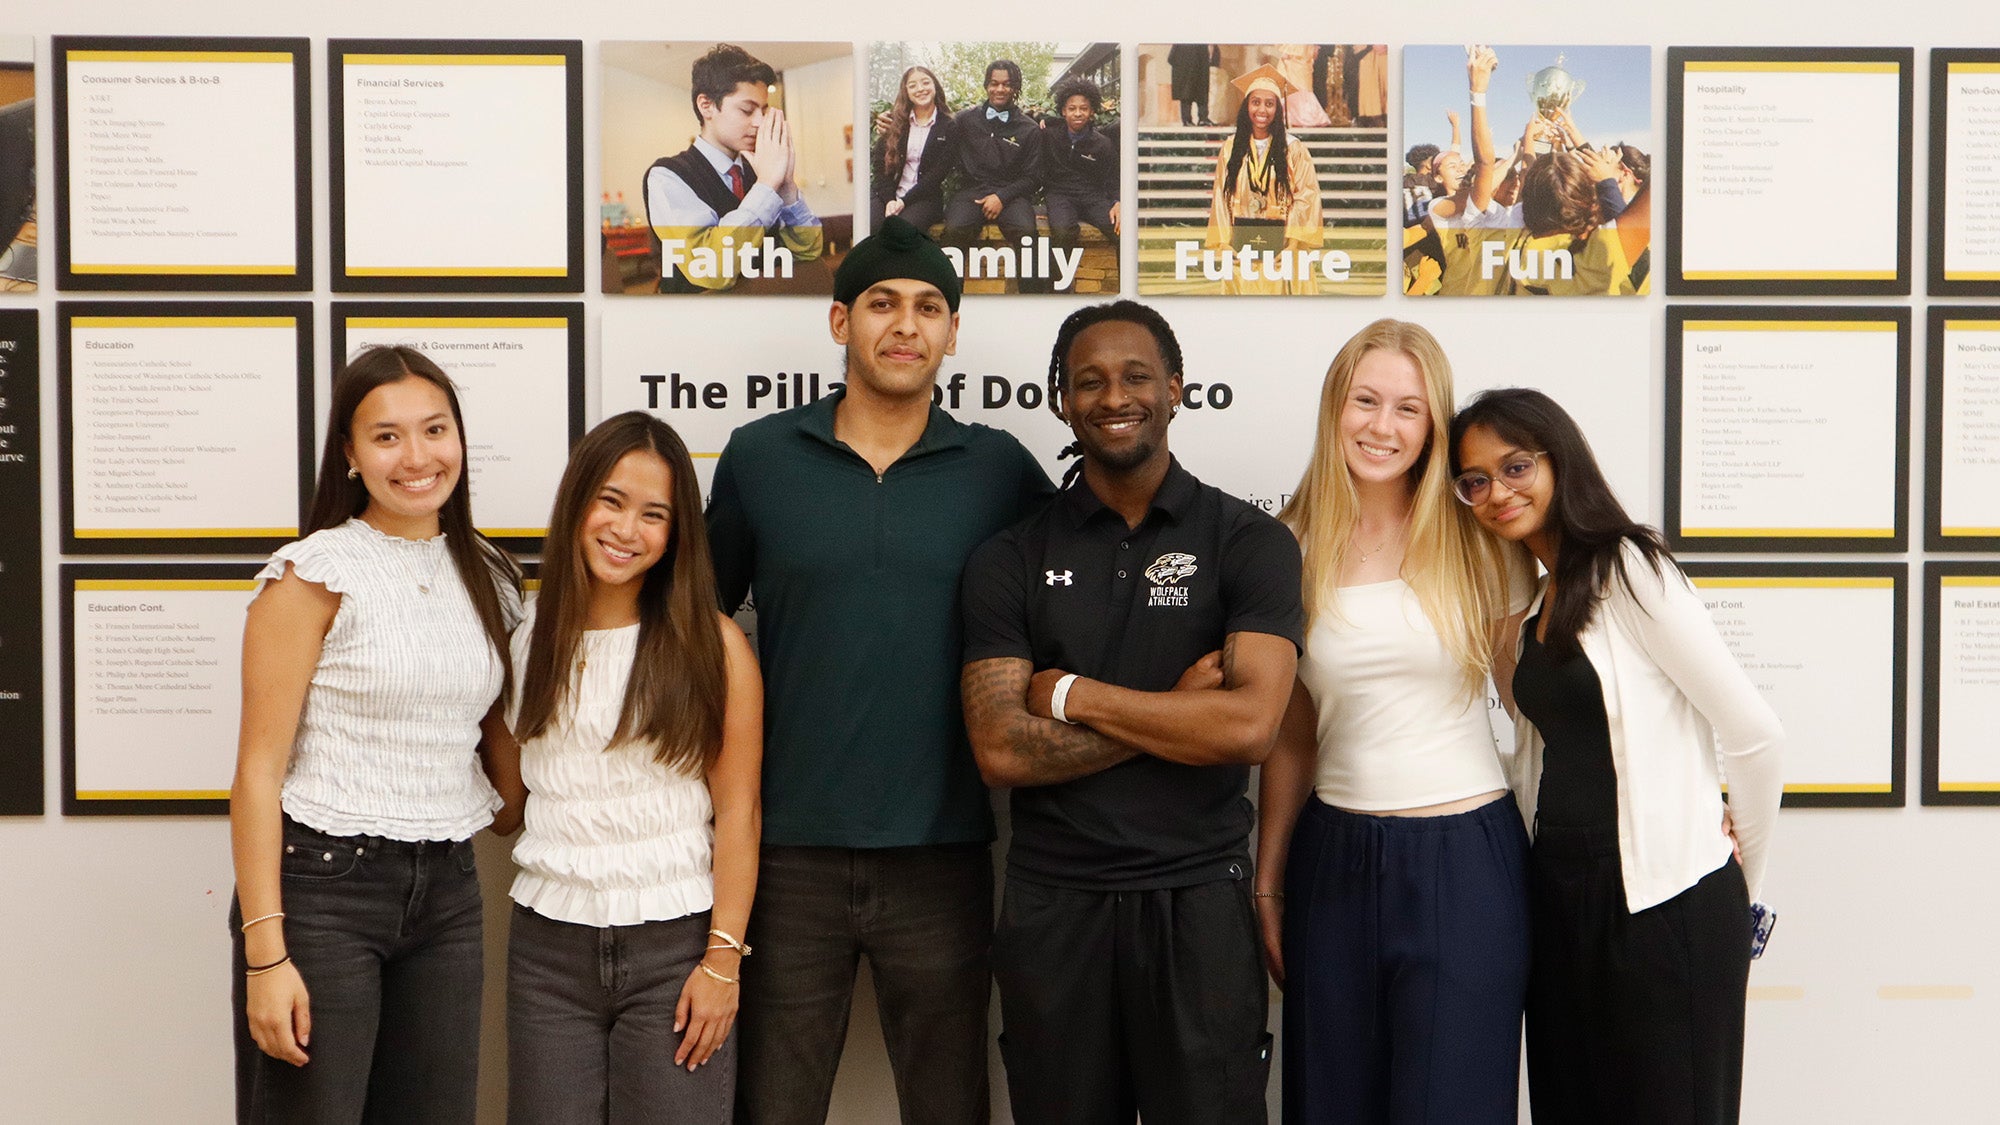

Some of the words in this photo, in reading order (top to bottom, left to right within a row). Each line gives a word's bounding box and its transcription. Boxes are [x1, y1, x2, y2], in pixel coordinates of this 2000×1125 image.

[82, 75, 132, 84] Consumer
[134, 75, 176, 84] Services
[178, 75, 186, 84] &
[189, 76, 220, 84] B-to-B
[357, 78, 400, 87] Financial
[403, 78, 444, 88] Services
[1697, 85, 1746, 95] Hospitality
[662, 236, 793, 278] Faith
[1175, 241, 1350, 281] Future
[1482, 241, 1574, 280] Fun
[941, 236, 1084, 290] amily
[85, 341, 134, 350] Education
[421, 342, 428, 350] &
[431, 342, 489, 350] Government
[492, 342, 523, 350] Affairs
[1696, 344, 1722, 353] Legal
[641, 374, 727, 410] The
[747, 372, 846, 409] Pill
[983, 375, 1052, 409] Do
[1150, 586, 1188, 597] WOLFPACK
[1148, 596, 1188, 606] ATHLETICS
[1704, 600, 1718, 610] gal
[1720, 601, 1745, 609] Cont.
[1954, 600, 1975, 609] Real
[88, 604, 136, 612] Education
[140, 604, 165, 612] Cont.
